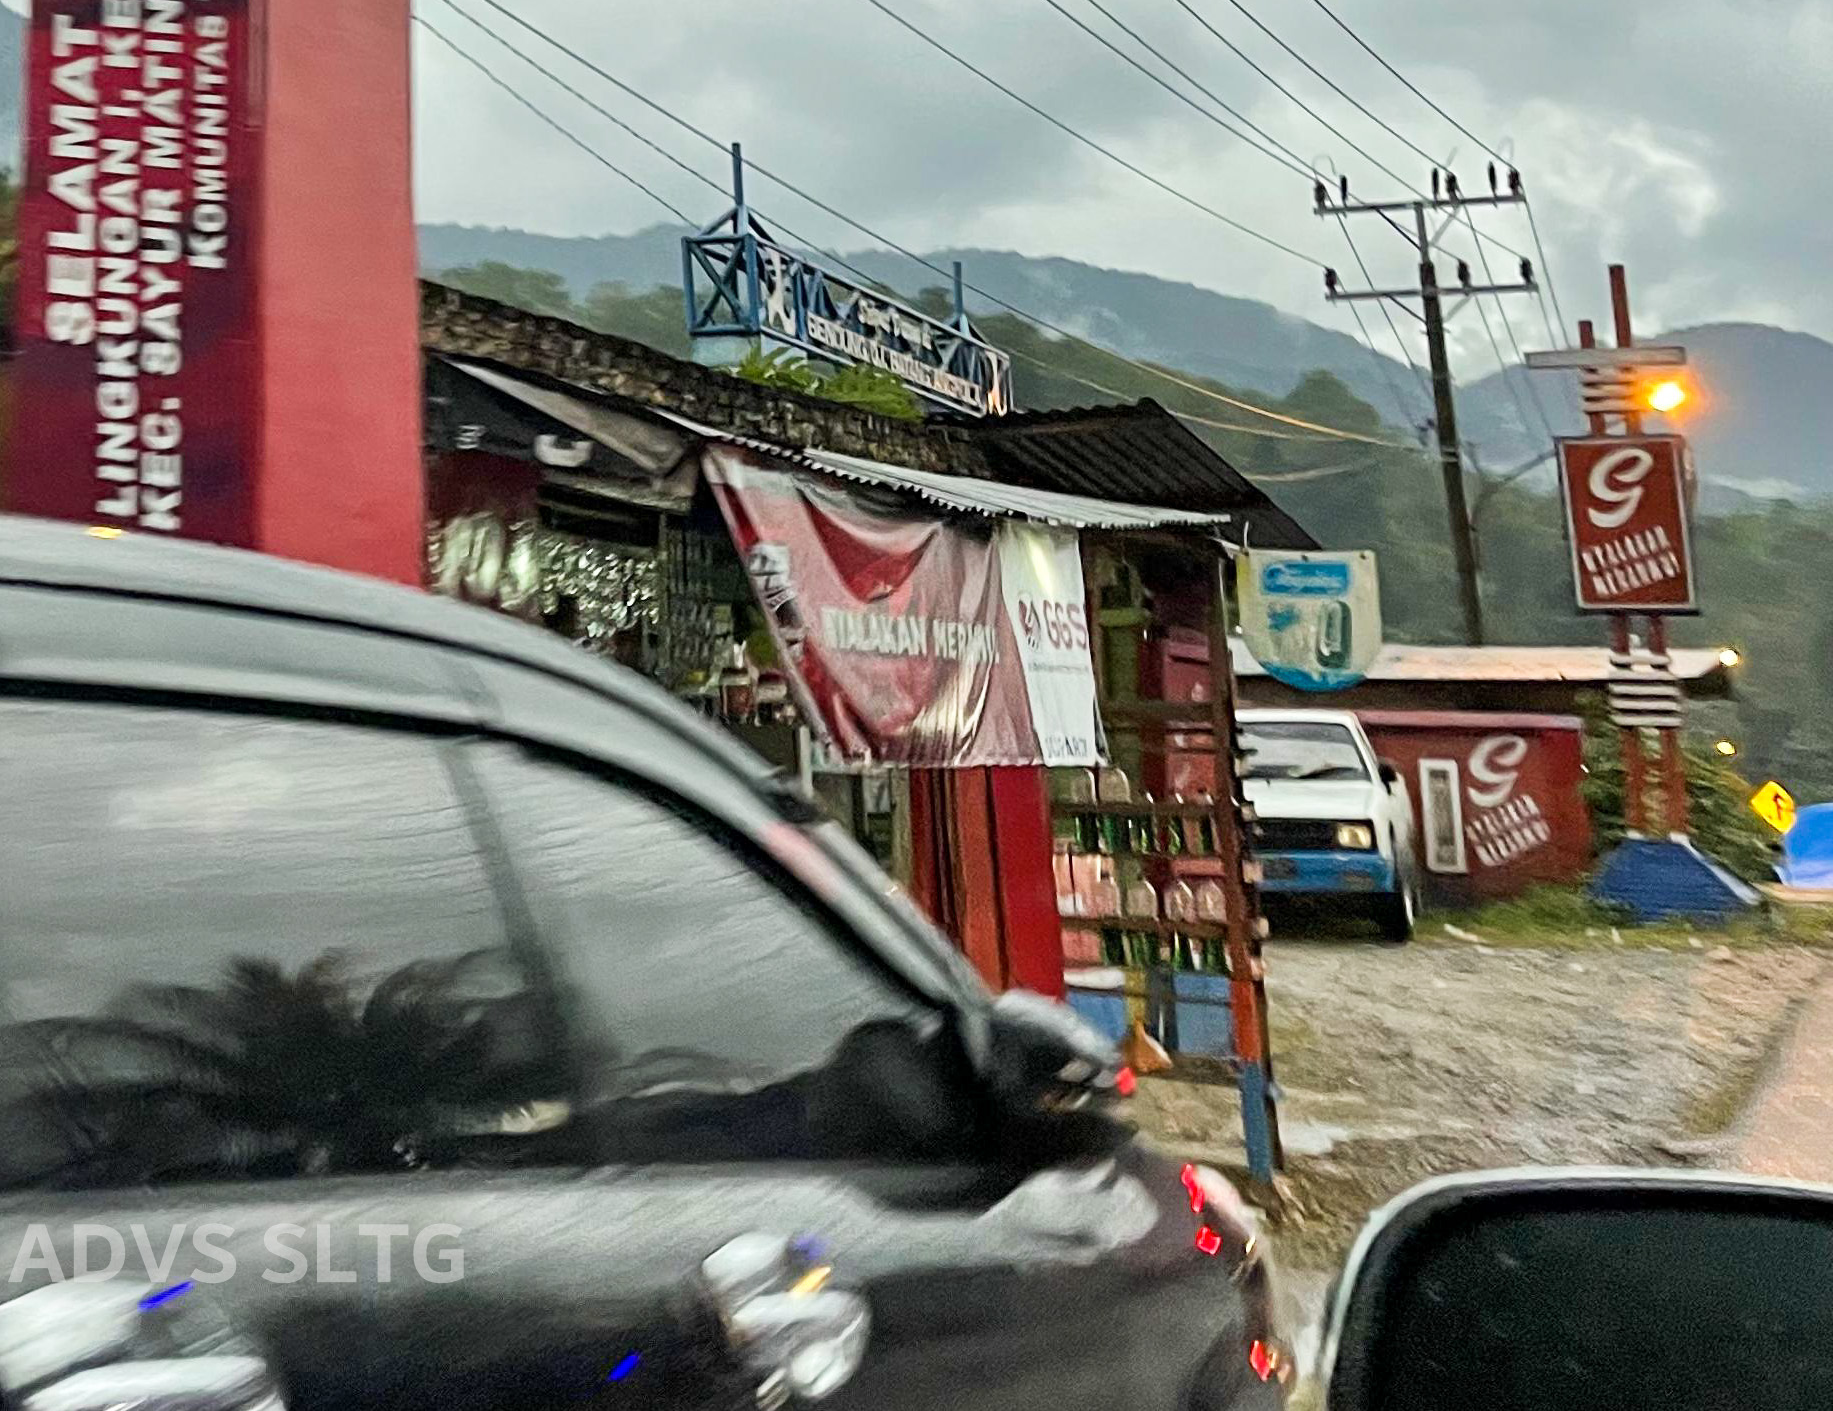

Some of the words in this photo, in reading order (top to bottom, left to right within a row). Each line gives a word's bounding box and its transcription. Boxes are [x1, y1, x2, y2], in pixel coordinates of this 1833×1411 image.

[45, 14, 99, 345] SELAMAT
[189, 15, 228, 269] KOMUNITAS
[96, 138, 139, 516] LINGKUNGAN
[140, 189, 182, 375] SAYUR
[140, 397, 182, 530] KEC.
[1043, 600, 1087, 650] GGS
